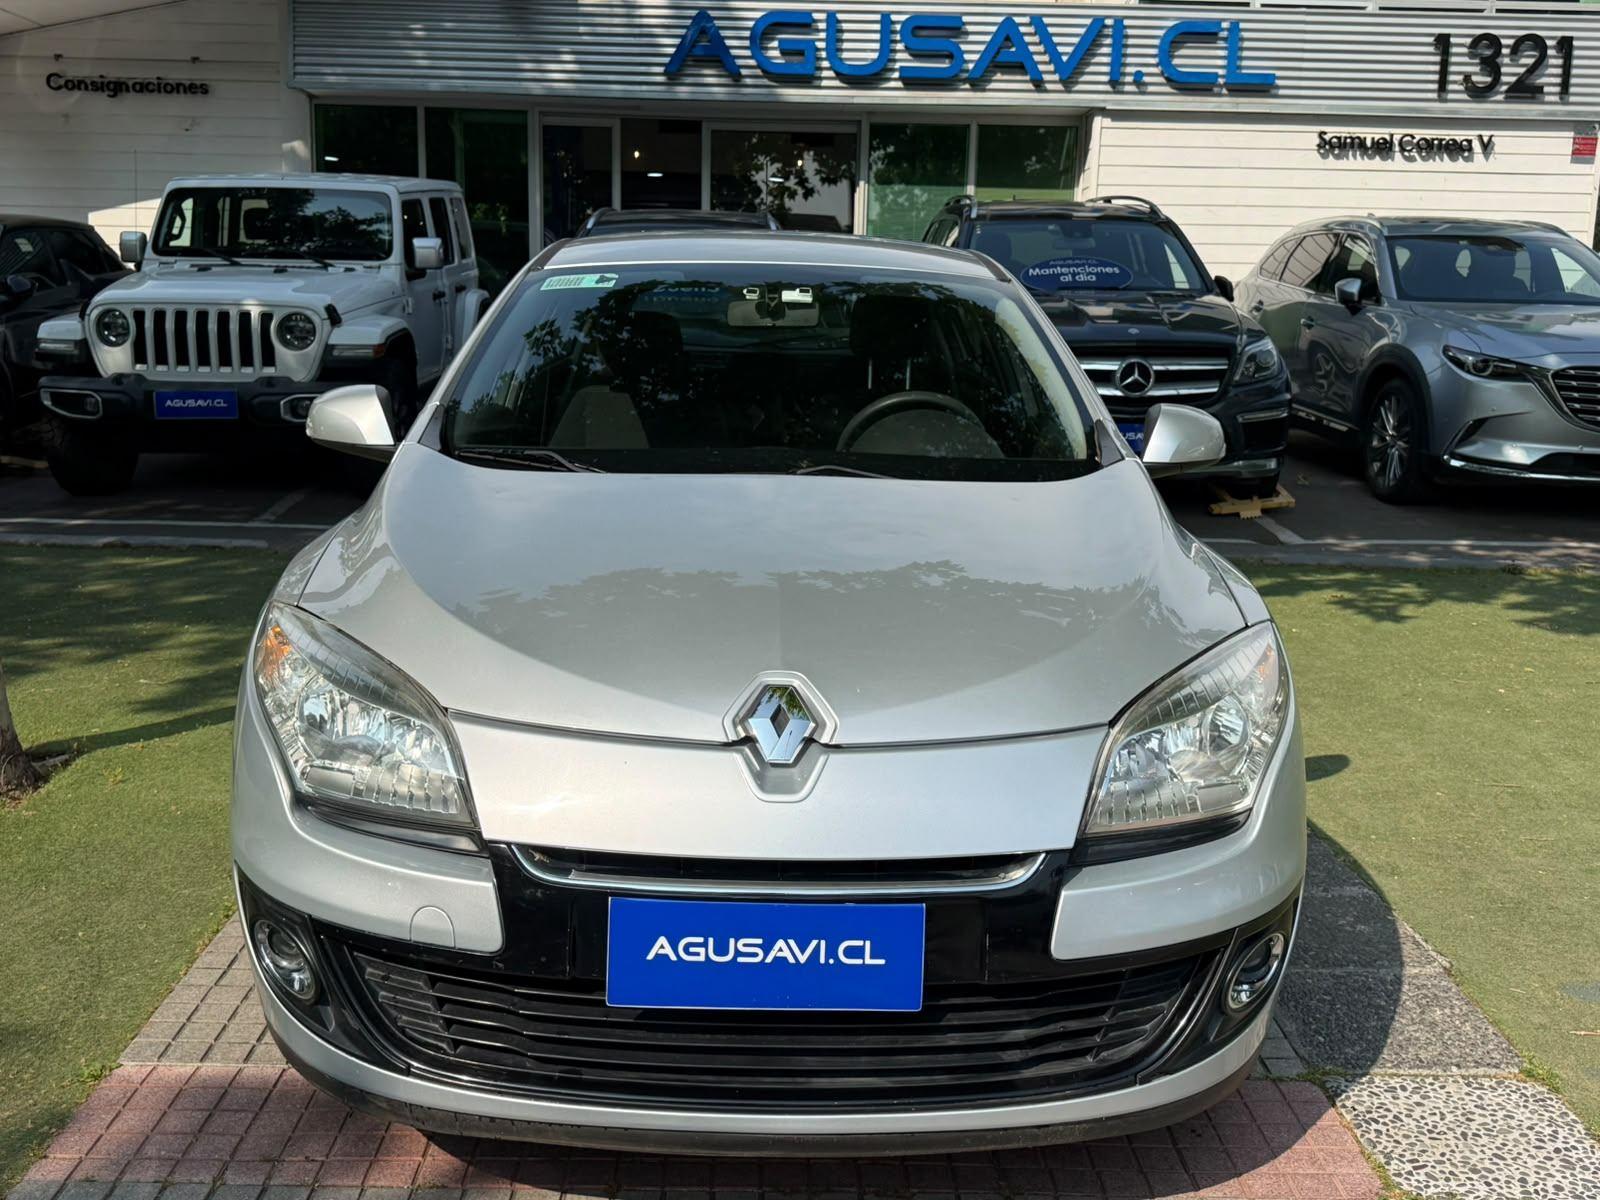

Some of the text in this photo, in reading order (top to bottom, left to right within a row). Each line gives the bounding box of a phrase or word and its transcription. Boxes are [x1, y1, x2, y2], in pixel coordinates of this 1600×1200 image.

[663, 9, 1277, 93] AGUSAVI.CL
[1433, 32, 1574, 101] 1321
[45, 72, 210, 98] Consignaciones
[1316, 130, 1495, 154] Samuel Correa V
[1028, 265, 1120, 277] Mantenciones
[1060, 273, 1073, 282] al
[646, 935, 886, 965] AGUSAVI.CL
